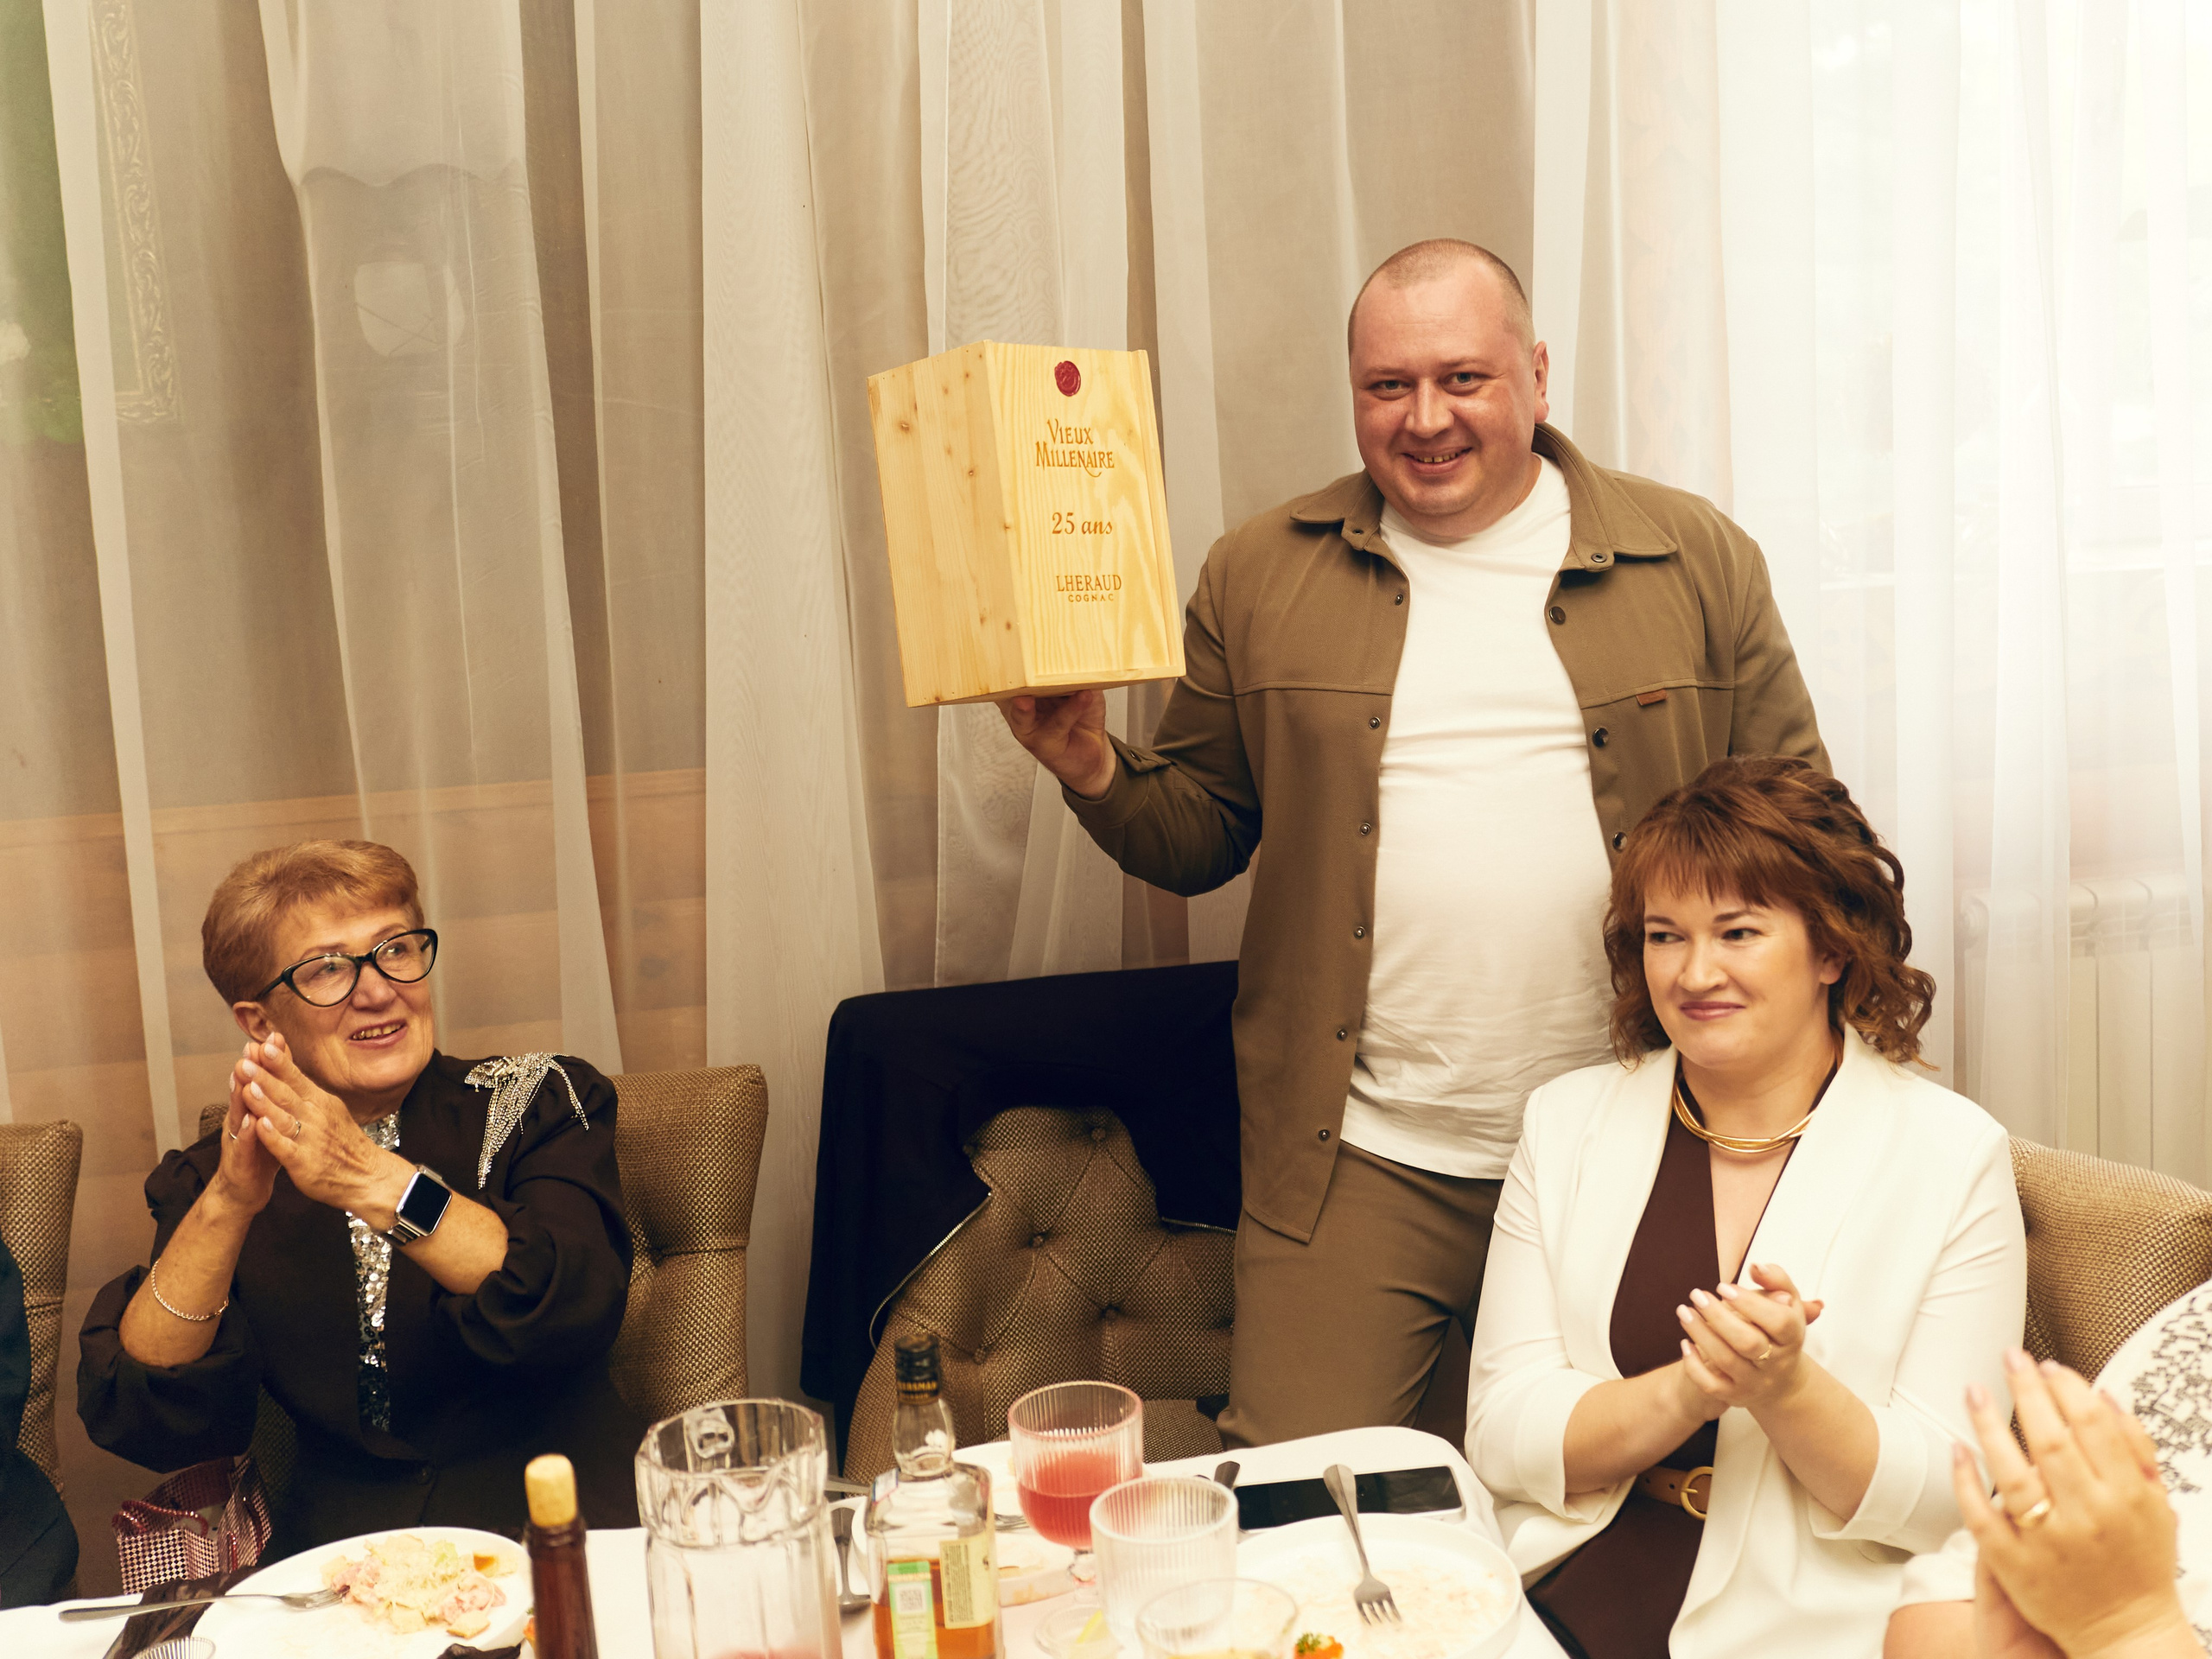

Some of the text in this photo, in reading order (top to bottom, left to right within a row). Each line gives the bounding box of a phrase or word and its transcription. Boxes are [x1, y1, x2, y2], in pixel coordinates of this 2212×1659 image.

[1035, 441, 1115, 478] MILLENAIRE
[1052, 512, 1113, 535] 25 ans
[1056, 575, 1122, 592] LHERAUD
[1068, 594, 1115, 603] COGNAC
